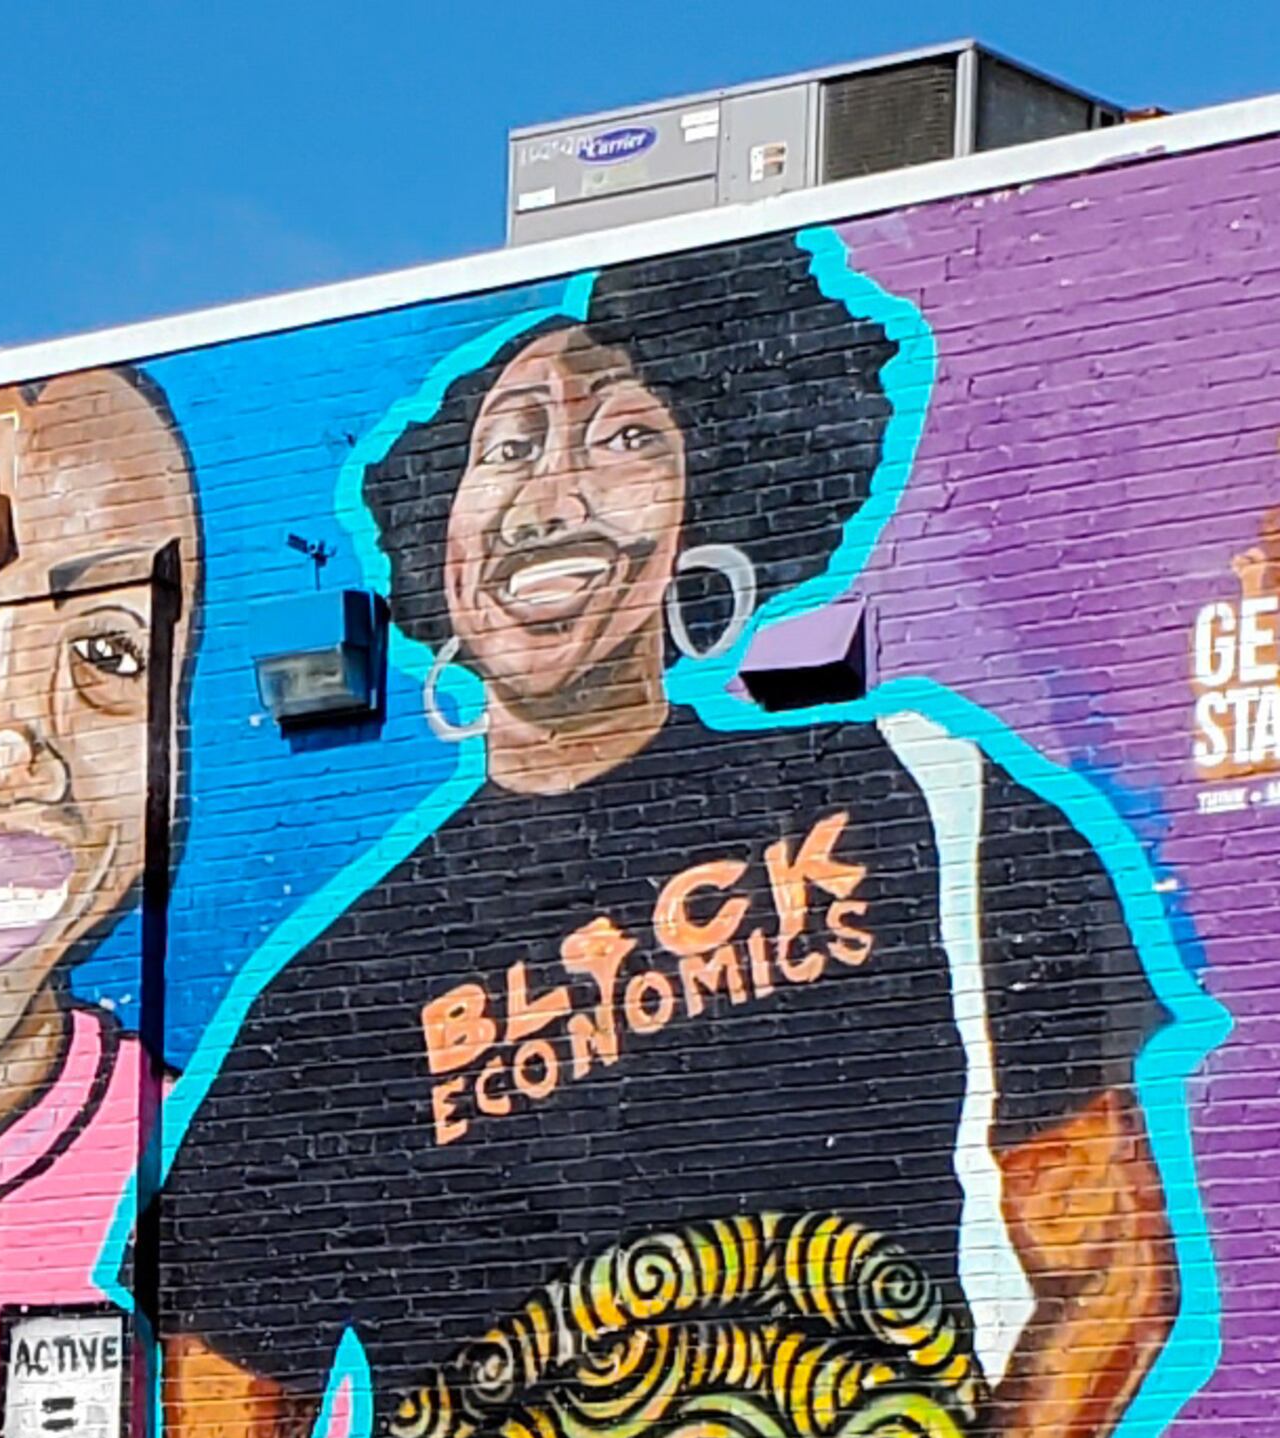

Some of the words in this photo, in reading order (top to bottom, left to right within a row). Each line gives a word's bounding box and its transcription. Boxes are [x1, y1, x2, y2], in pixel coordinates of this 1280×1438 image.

[582, 131, 647, 160] Carrier
[431, 900, 874, 1145] ECONOMICS
[14, 1335, 118, 1376] ACTIVE
